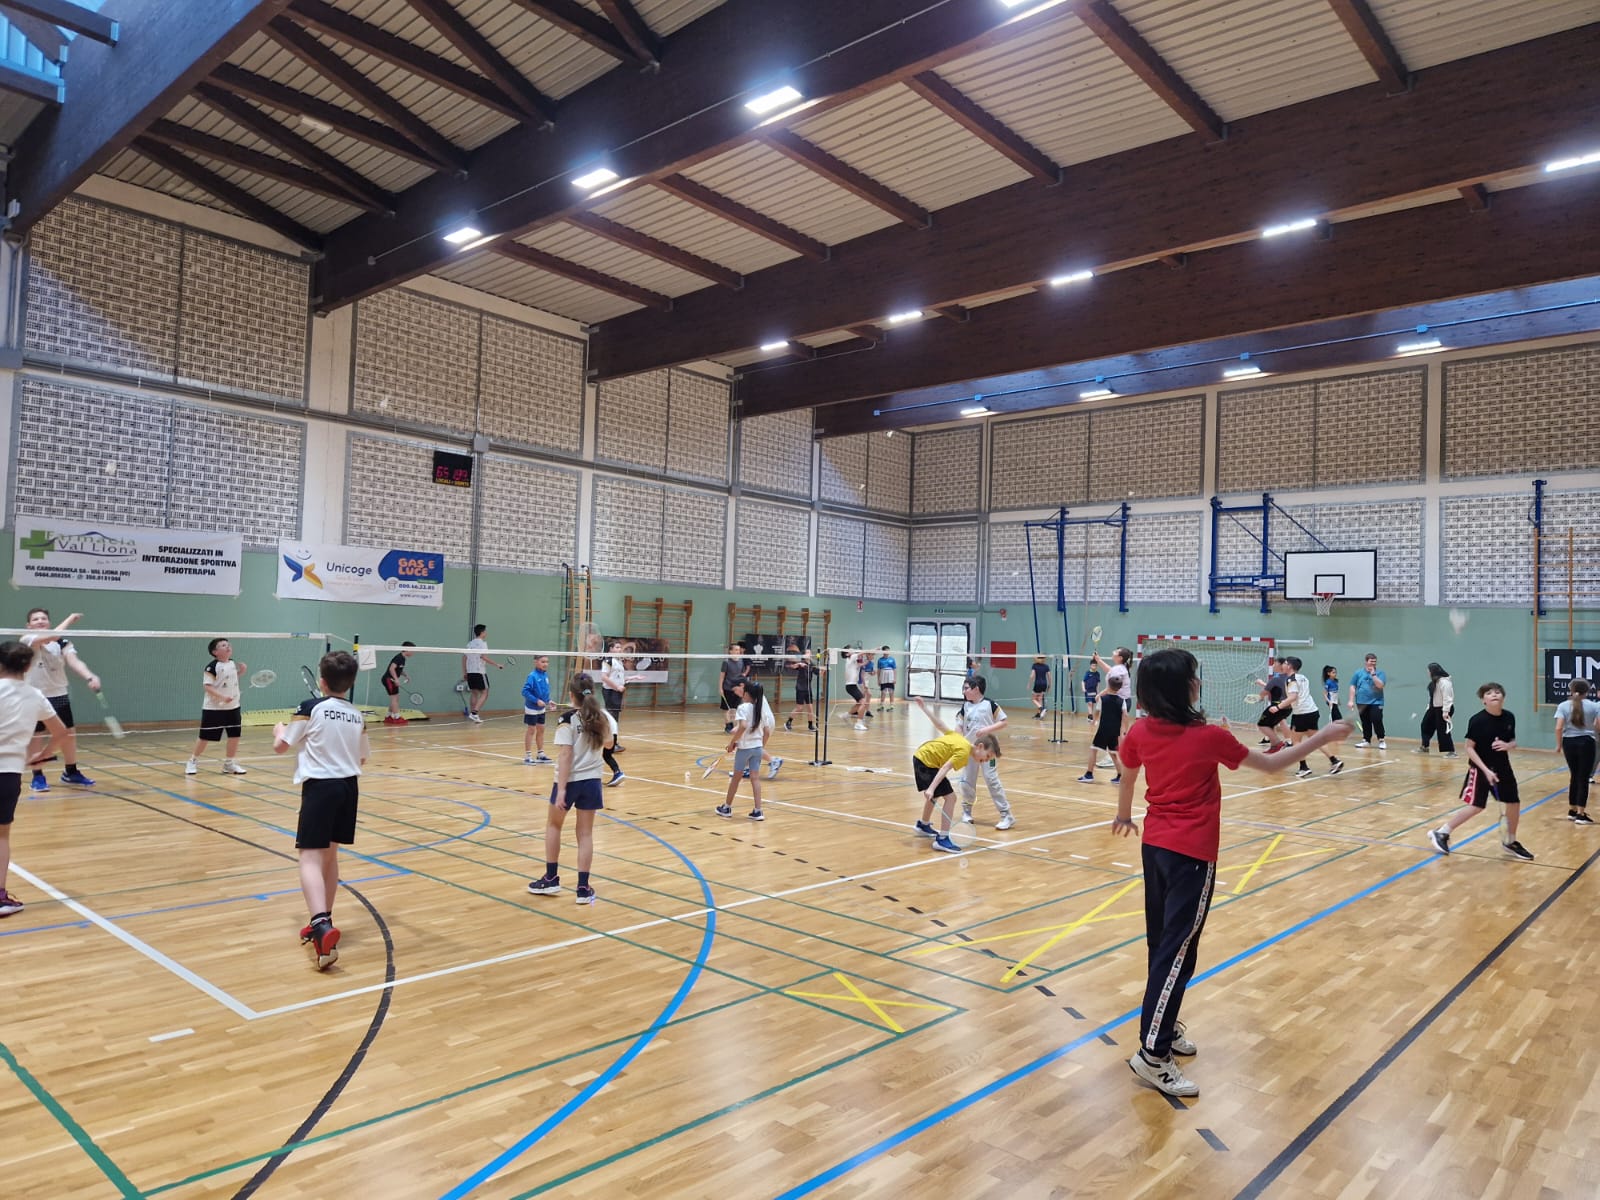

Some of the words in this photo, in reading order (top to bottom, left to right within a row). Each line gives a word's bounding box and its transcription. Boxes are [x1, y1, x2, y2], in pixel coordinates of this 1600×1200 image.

[58, 540, 84, 551] Val
[92, 542, 137, 555] Liona
[158, 545, 214, 557] SPECIALIZZATI
[142, 554, 199, 565] INTEGRAZIONE
[200, 558, 237, 567] SPORTIVA
[398, 557, 425, 569] GAS
[428, 560, 436, 569] E
[164, 566, 216, 576] FISIOTERAPIA
[326, 561, 373, 577] Unicoge
[398, 566, 429, 577] LUCE
